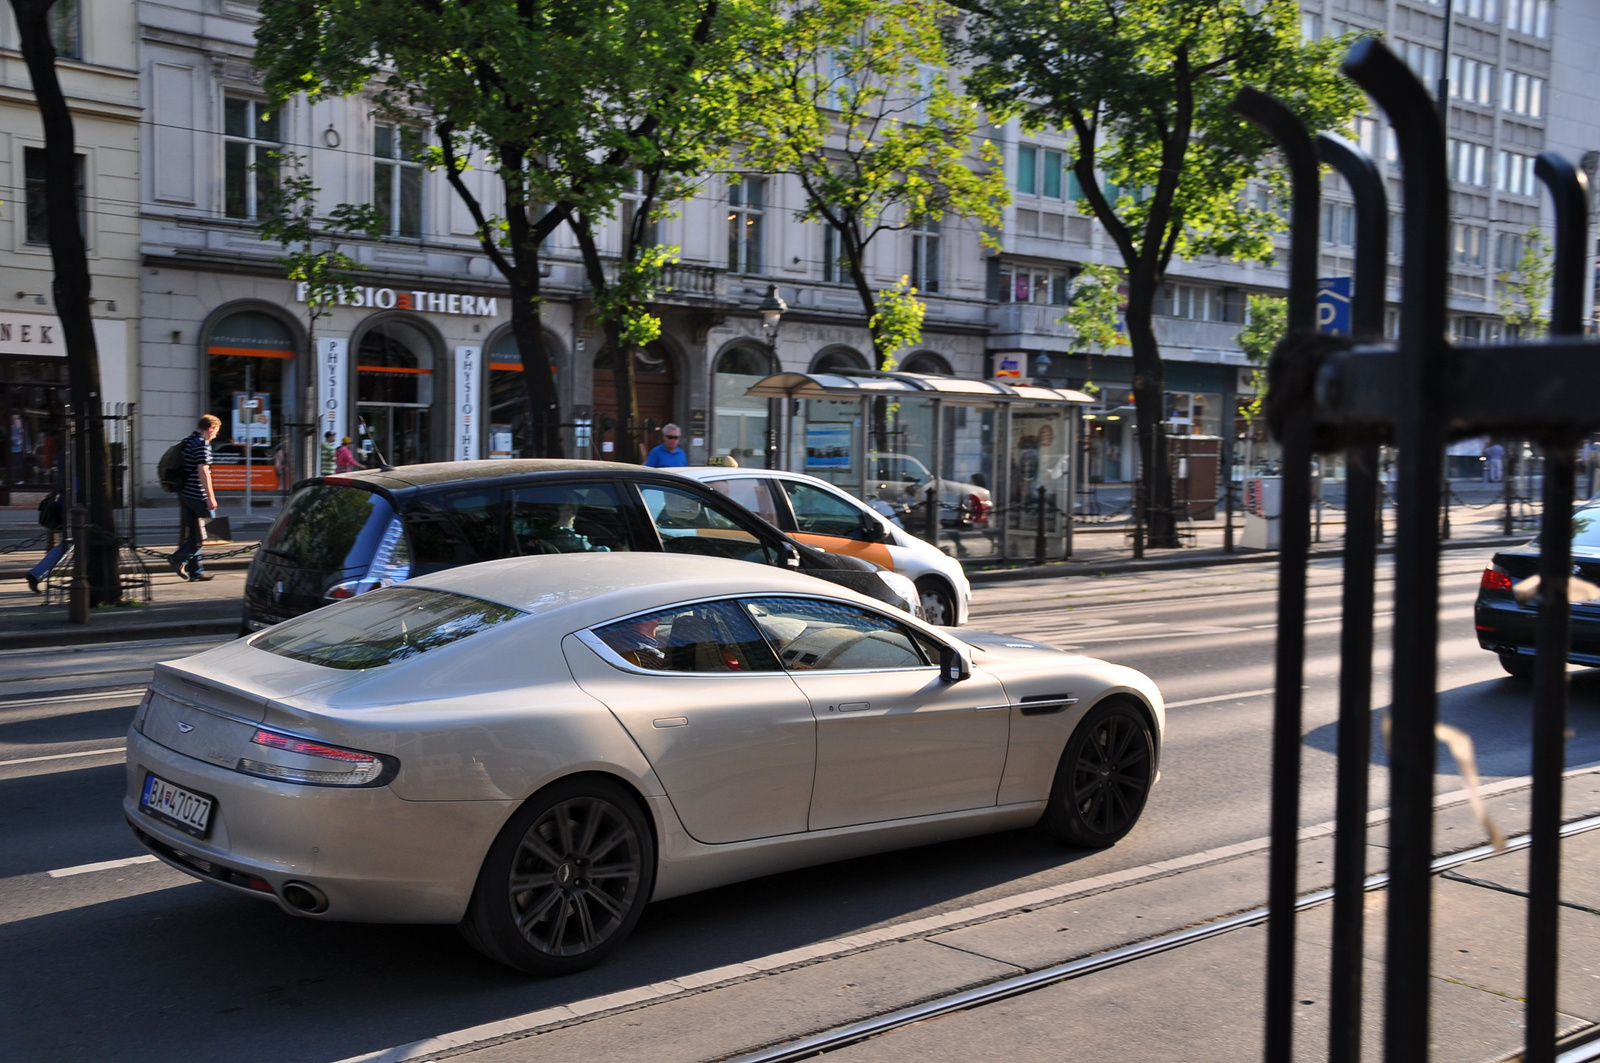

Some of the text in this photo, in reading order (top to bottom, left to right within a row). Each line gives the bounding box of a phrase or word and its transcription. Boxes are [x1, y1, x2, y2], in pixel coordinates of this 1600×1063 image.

[411, 290, 498, 317] THERM
[326, 341, 338, 410] PHYSIO
[461, 350, 473, 461] PHYSIO THE
[149, 780, 209, 828] BA 470ZZ
